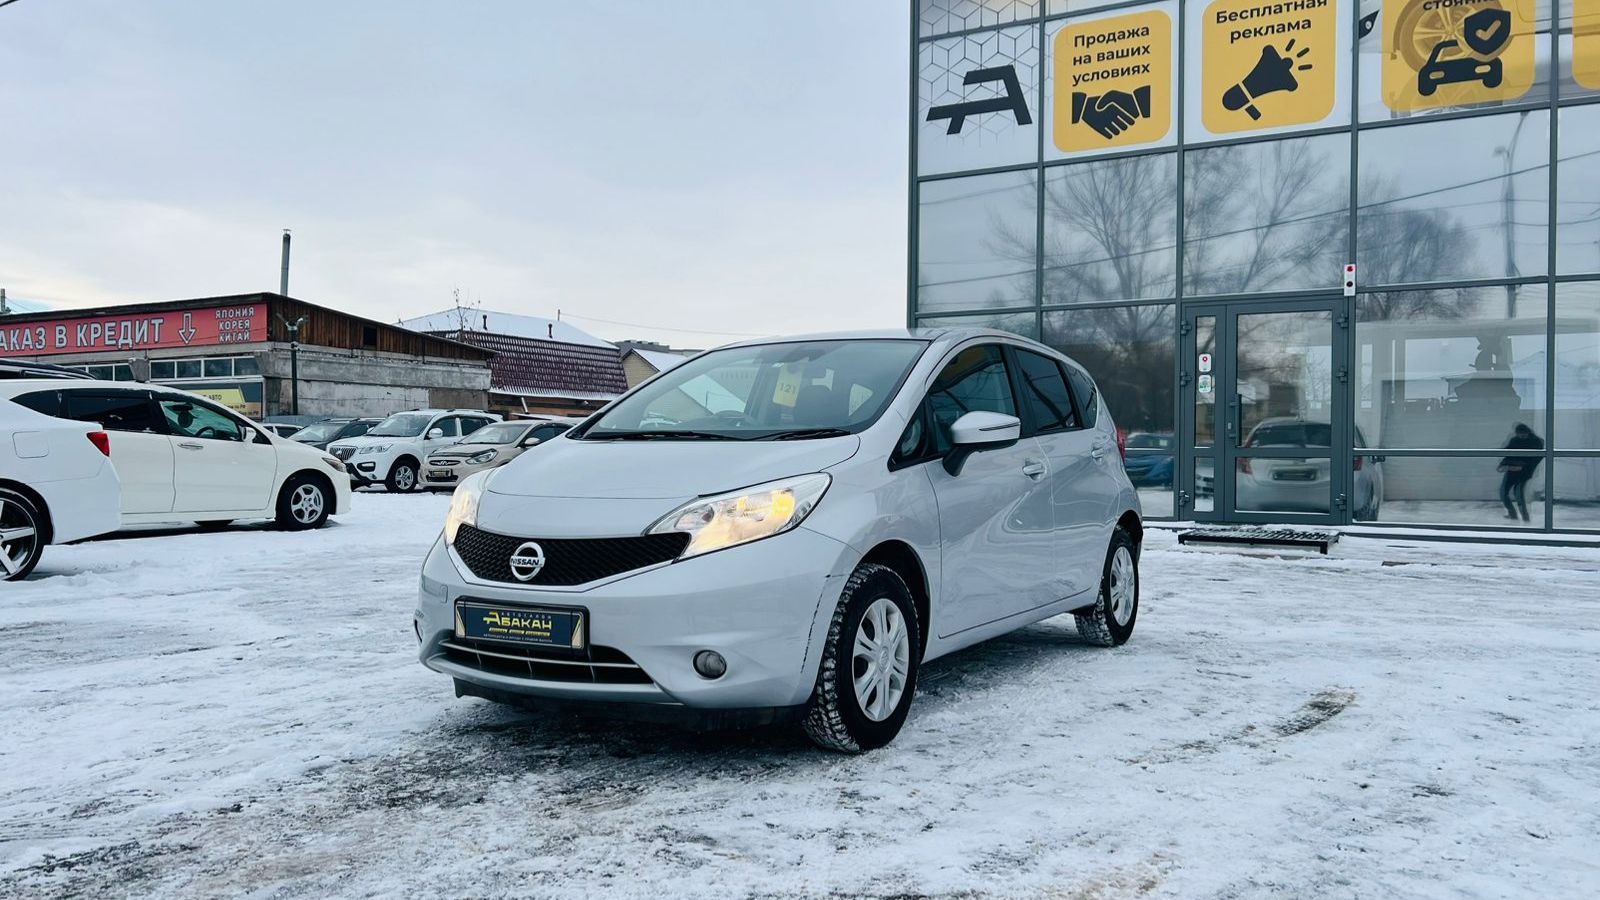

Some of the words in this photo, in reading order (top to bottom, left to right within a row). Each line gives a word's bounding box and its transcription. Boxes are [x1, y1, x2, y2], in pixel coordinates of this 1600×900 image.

[1216, 0, 1328, 24] Бесплатная
[1074, 26, 1150, 48] Продажа
[1230, 19, 1312, 44] реклама
[1073, 54, 1092, 66] на
[1096, 45, 1151, 62] ваших
[1072, 63, 1151, 87] условиях
[215, 306, 255, 319] ЯПОНИЯ
[55, 325, 68, 348] В
[77, 318, 164, 349] КРЕДИТ
[219, 319, 250, 330] КОРЕЯ
[219, 330, 250, 342] КИТАЙ
[780, 383, 796, 394] 121
[510, 557, 540, 566] NISSAN
